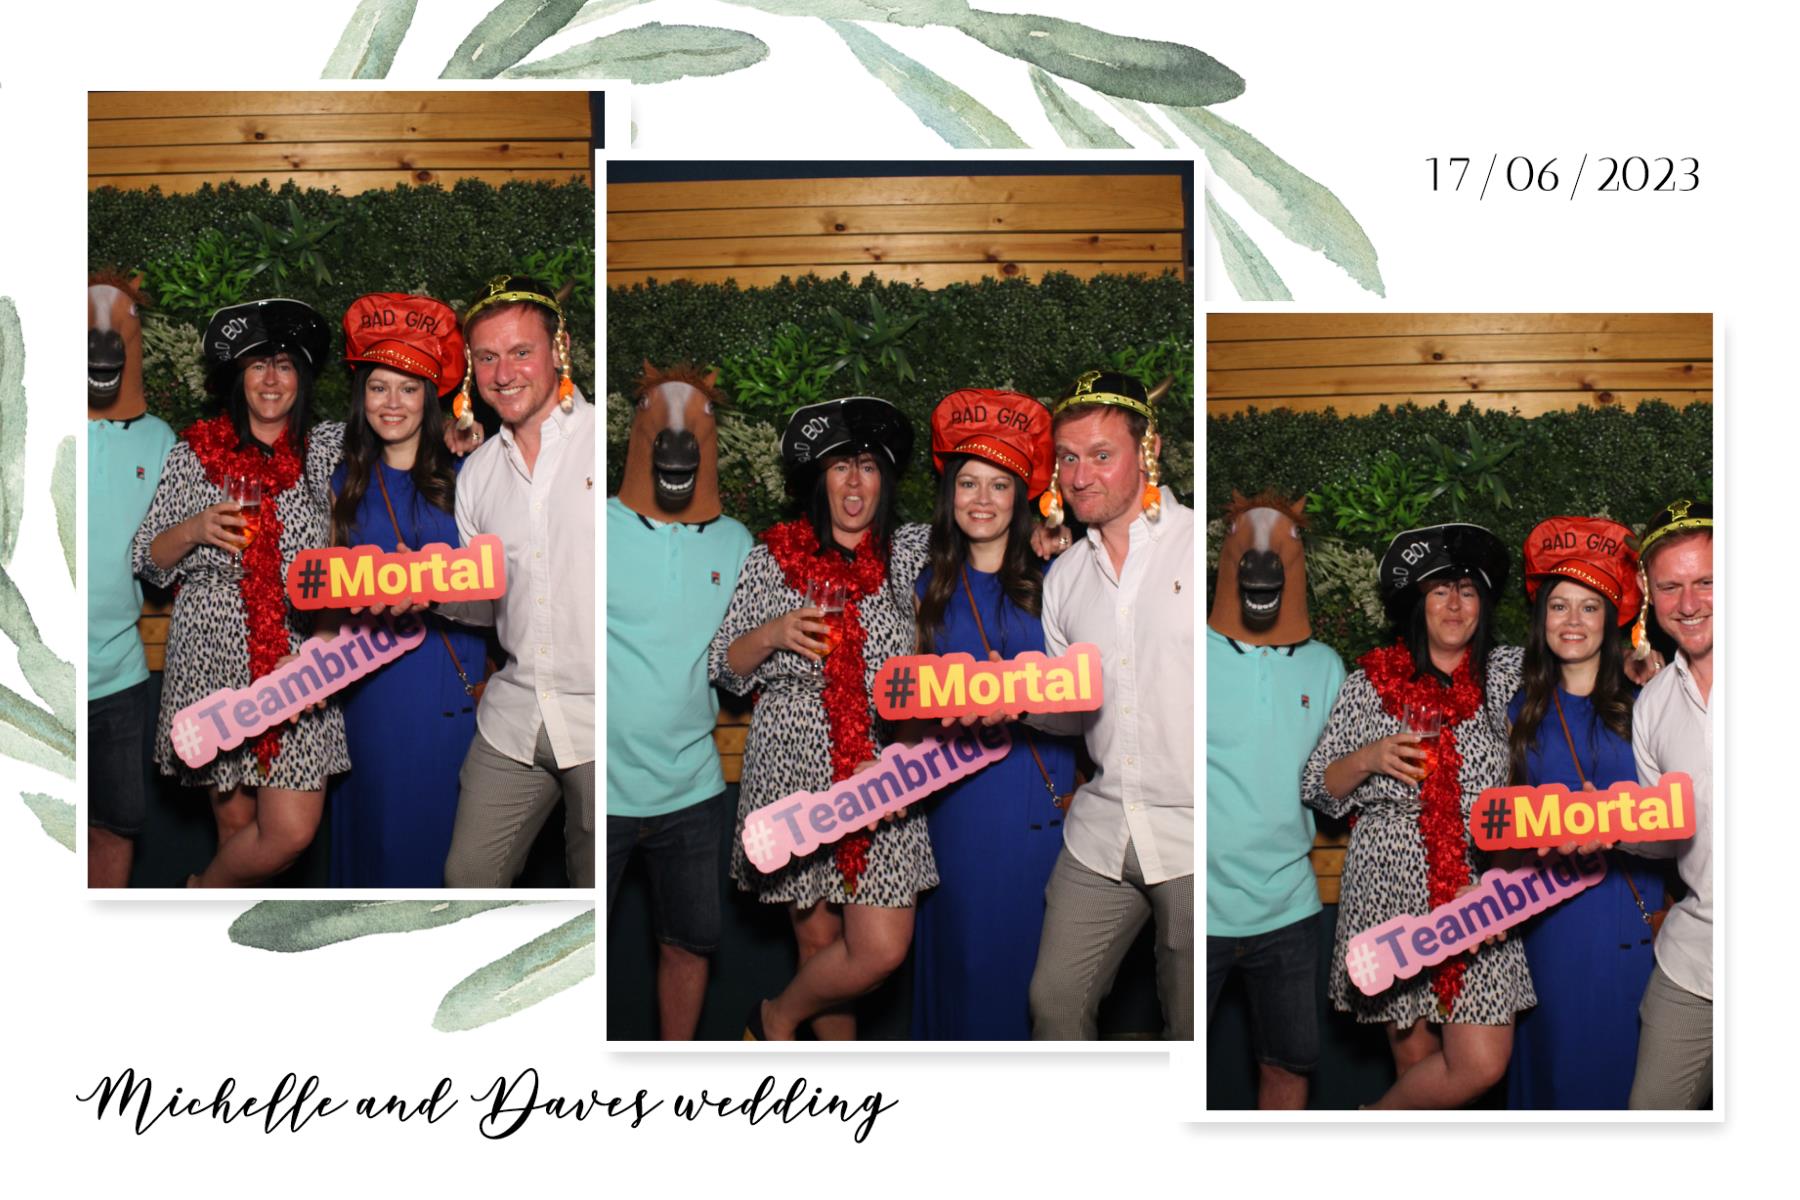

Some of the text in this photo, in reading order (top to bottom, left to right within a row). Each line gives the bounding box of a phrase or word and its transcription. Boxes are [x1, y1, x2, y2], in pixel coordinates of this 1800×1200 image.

[220, 316, 249, 341] BOY
[361, 310, 442, 336] BAD GIRL
[800, 415, 831, 441] BOY
[951, 405, 1035, 433] BAD GIRL
[1401, 541, 1431, 566] BOY
[1542, 532, 1577, 551] BAD
[297, 544, 496, 600] #Mortal
[174, 611, 422, 761] #Teambride
[884, 653, 1092, 710] #Mortal
[745, 724, 1009, 865] #Teambride
[1481, 782, 1685, 840] #Mortal
[1349, 850, 1601, 988] #Teambride
